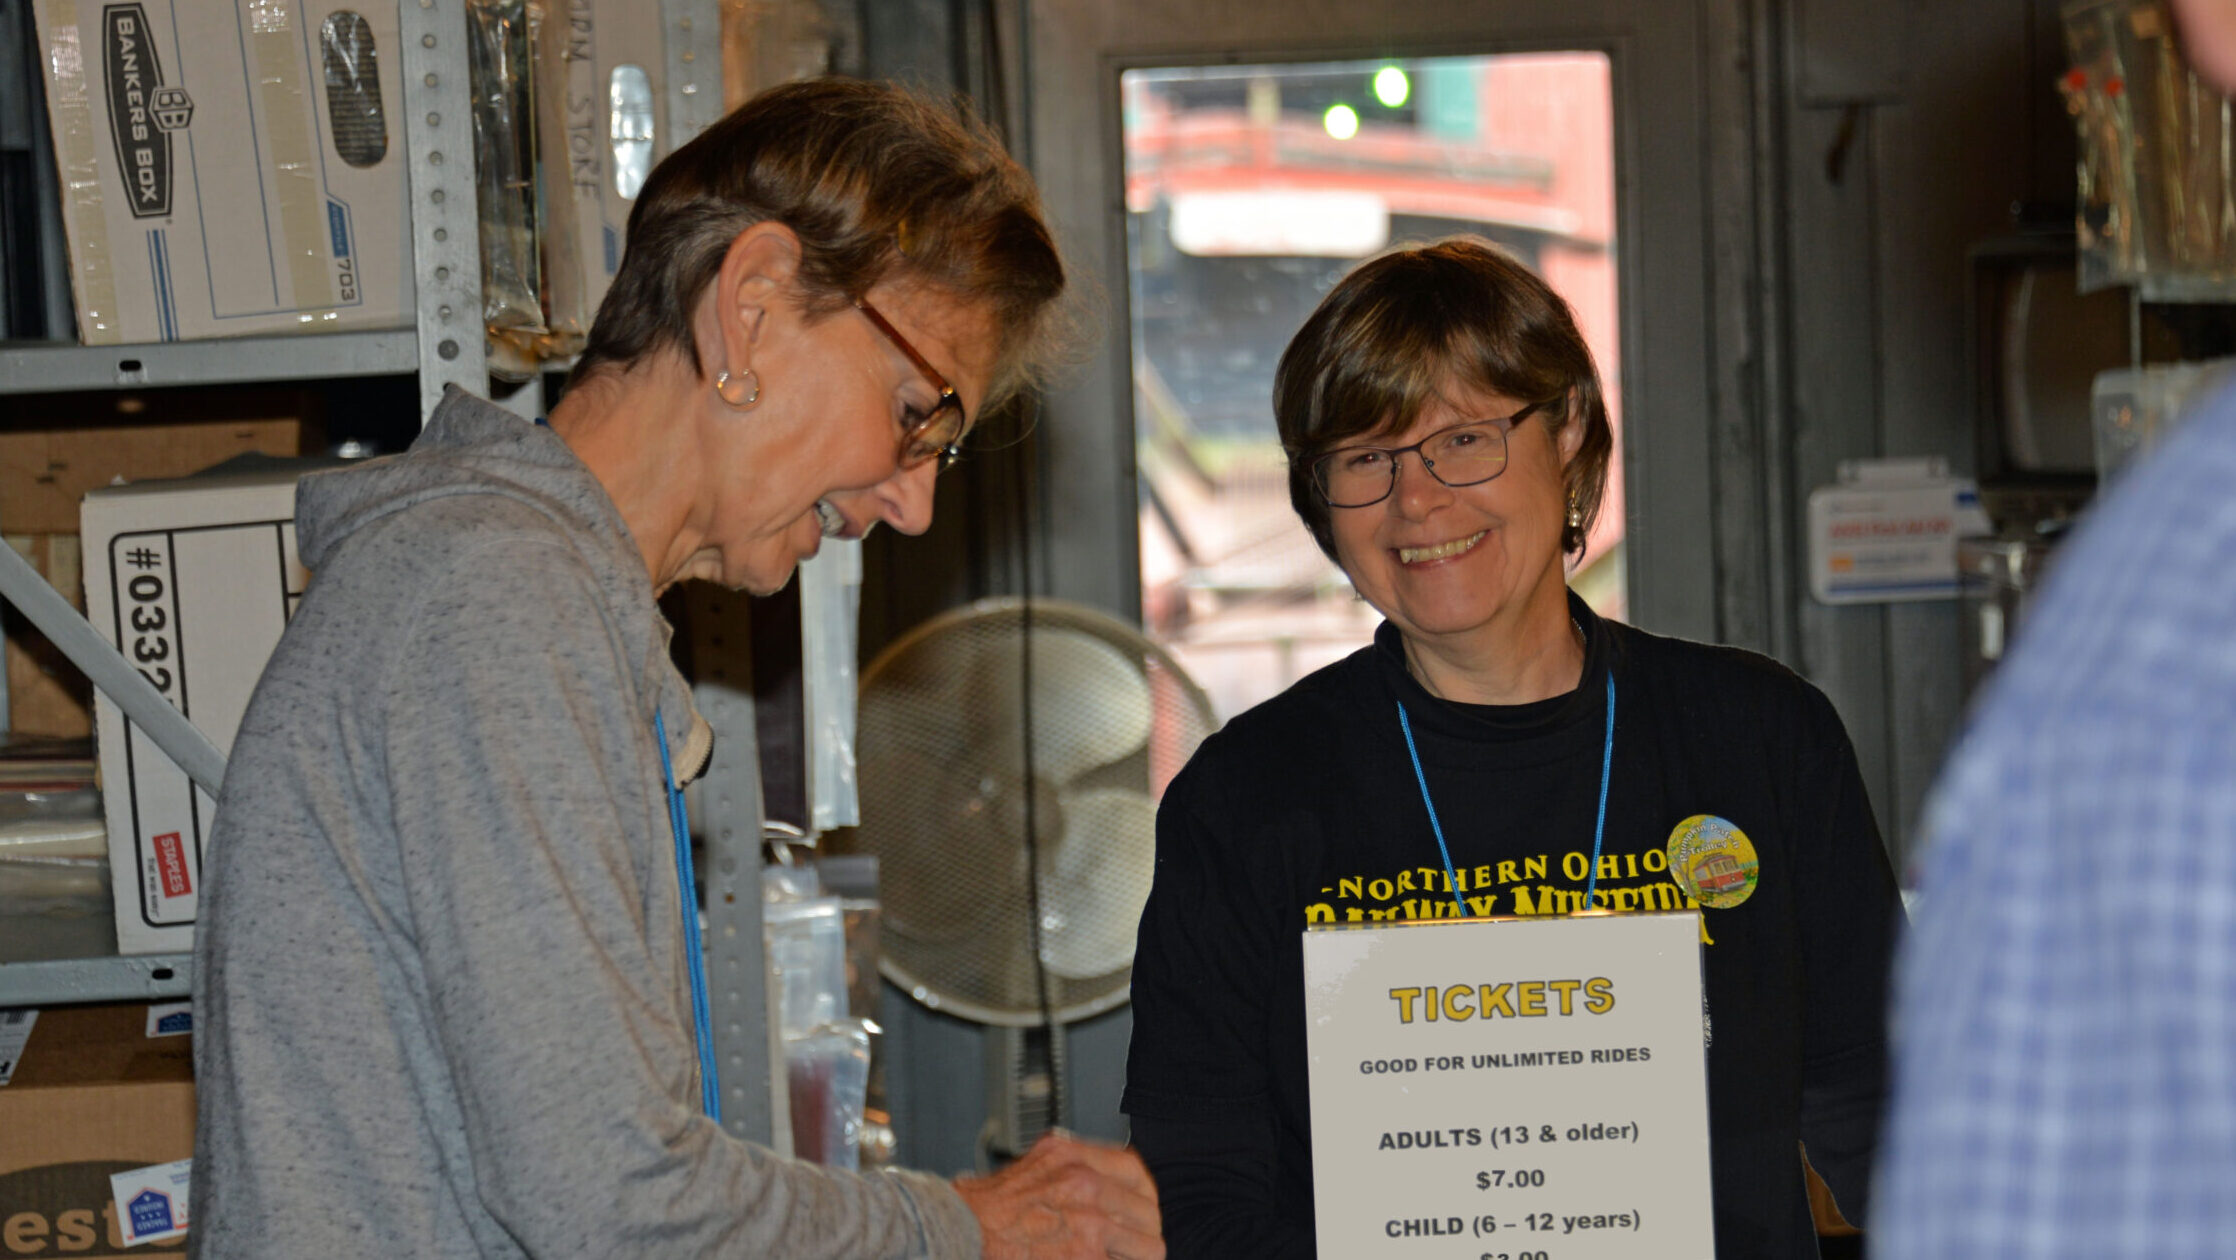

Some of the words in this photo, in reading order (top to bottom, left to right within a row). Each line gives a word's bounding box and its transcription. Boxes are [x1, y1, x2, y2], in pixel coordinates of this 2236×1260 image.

[116, 15, 149, 142] BANKERS
[135, 148, 158, 203] BOX
[337, 258, 356, 301] 703
[126, 546, 174, 706] #0332
[160, 836, 184, 893] STAPLES
[1562, 849, 1668, 881] OHIO
[1388, 976, 1616, 1025] TICKETS
[1359, 1058, 1418, 1075] GOOD
[1424, 1055, 1465, 1072] FOR
[1471, 1050, 1584, 1069] UNLIMITED
[1590, 1047, 1651, 1063] RIDES
[1378, 1127, 1482, 1151] ADULTS
[1490, 1125, 1530, 1150] (13
[1538, 1124, 1558, 1143] &
[1566, 1121, 1639, 1143] older)
[1476, 1169, 1545, 1192] $7.00
[1385, 1216, 1464, 1238] CHILD
[1472, 1215, 1497, 1239] (6
[1524, 1212, 1555, 1232] 12
[1562, 1209, 1641, 1235] years)
